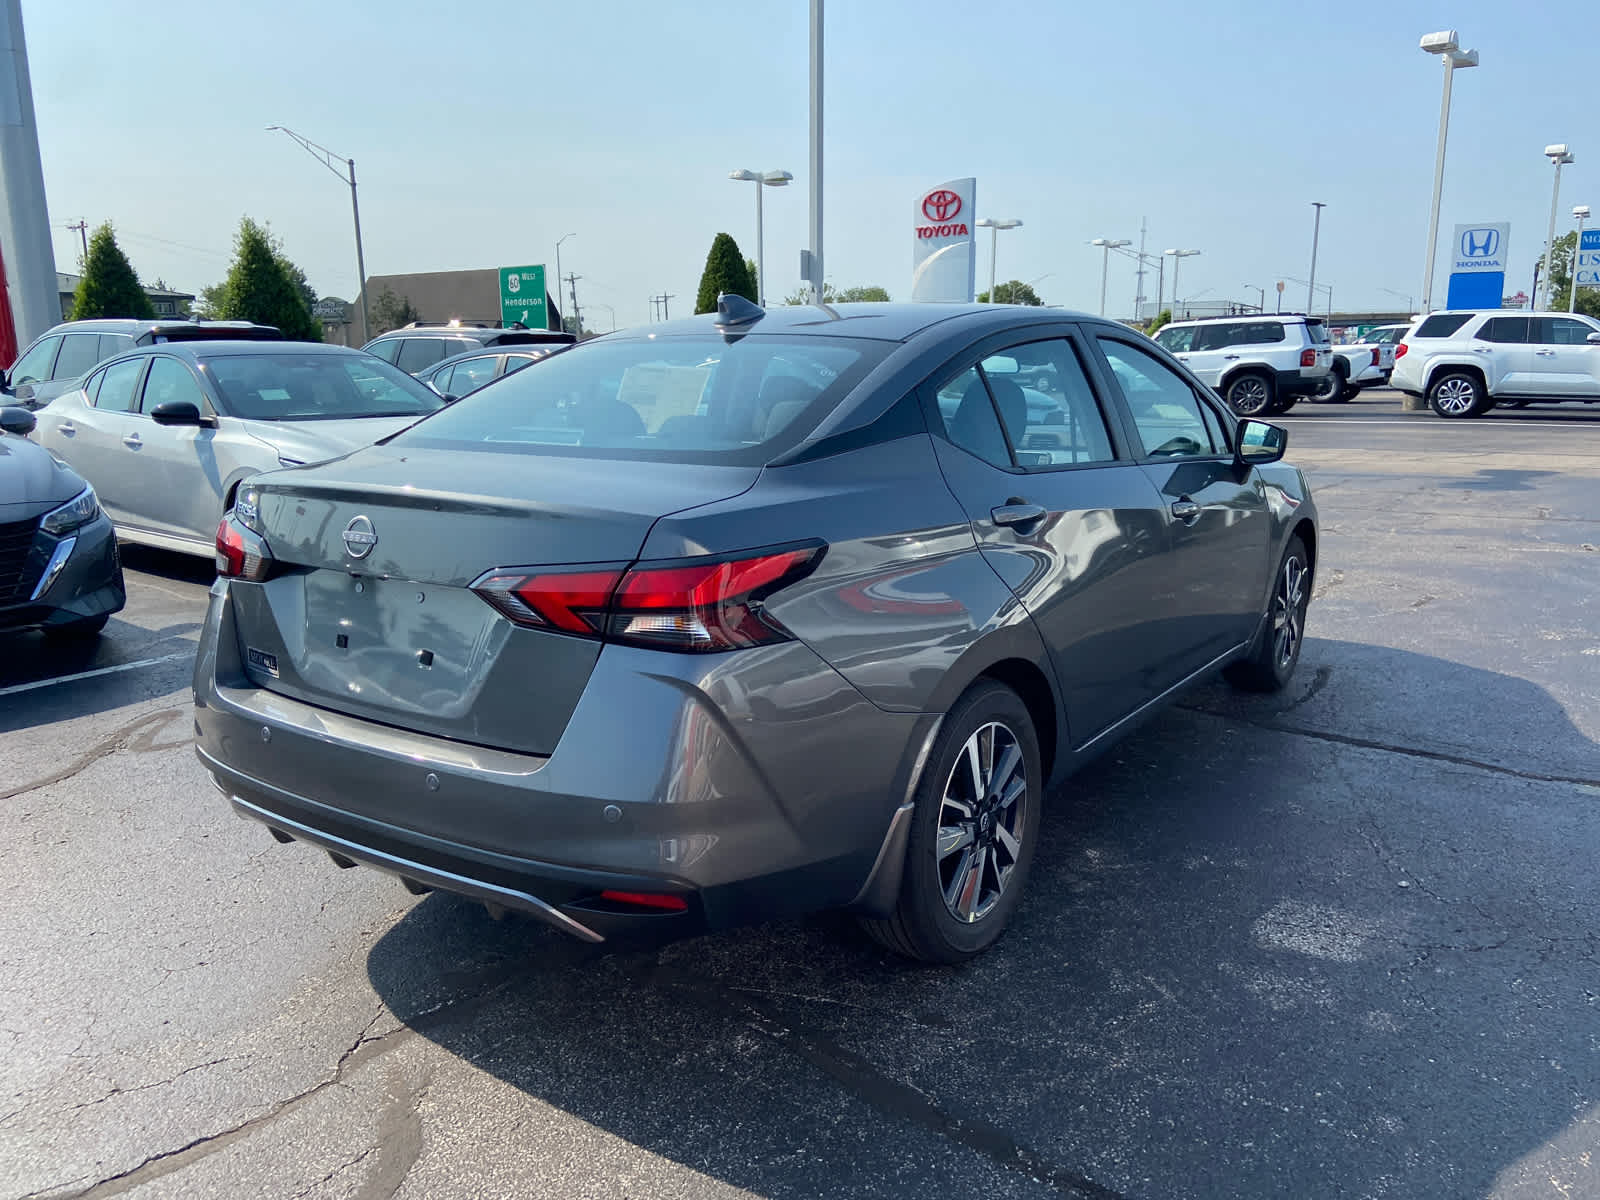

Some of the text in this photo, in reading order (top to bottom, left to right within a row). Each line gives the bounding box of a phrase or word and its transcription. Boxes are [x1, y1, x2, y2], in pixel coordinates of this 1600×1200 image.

[916, 224, 968, 239] TOYOTA
[1456, 260, 1500, 268] HONDA
[510, 272, 536, 288] 60 WEST
[505, 298, 542, 306] Henderson
